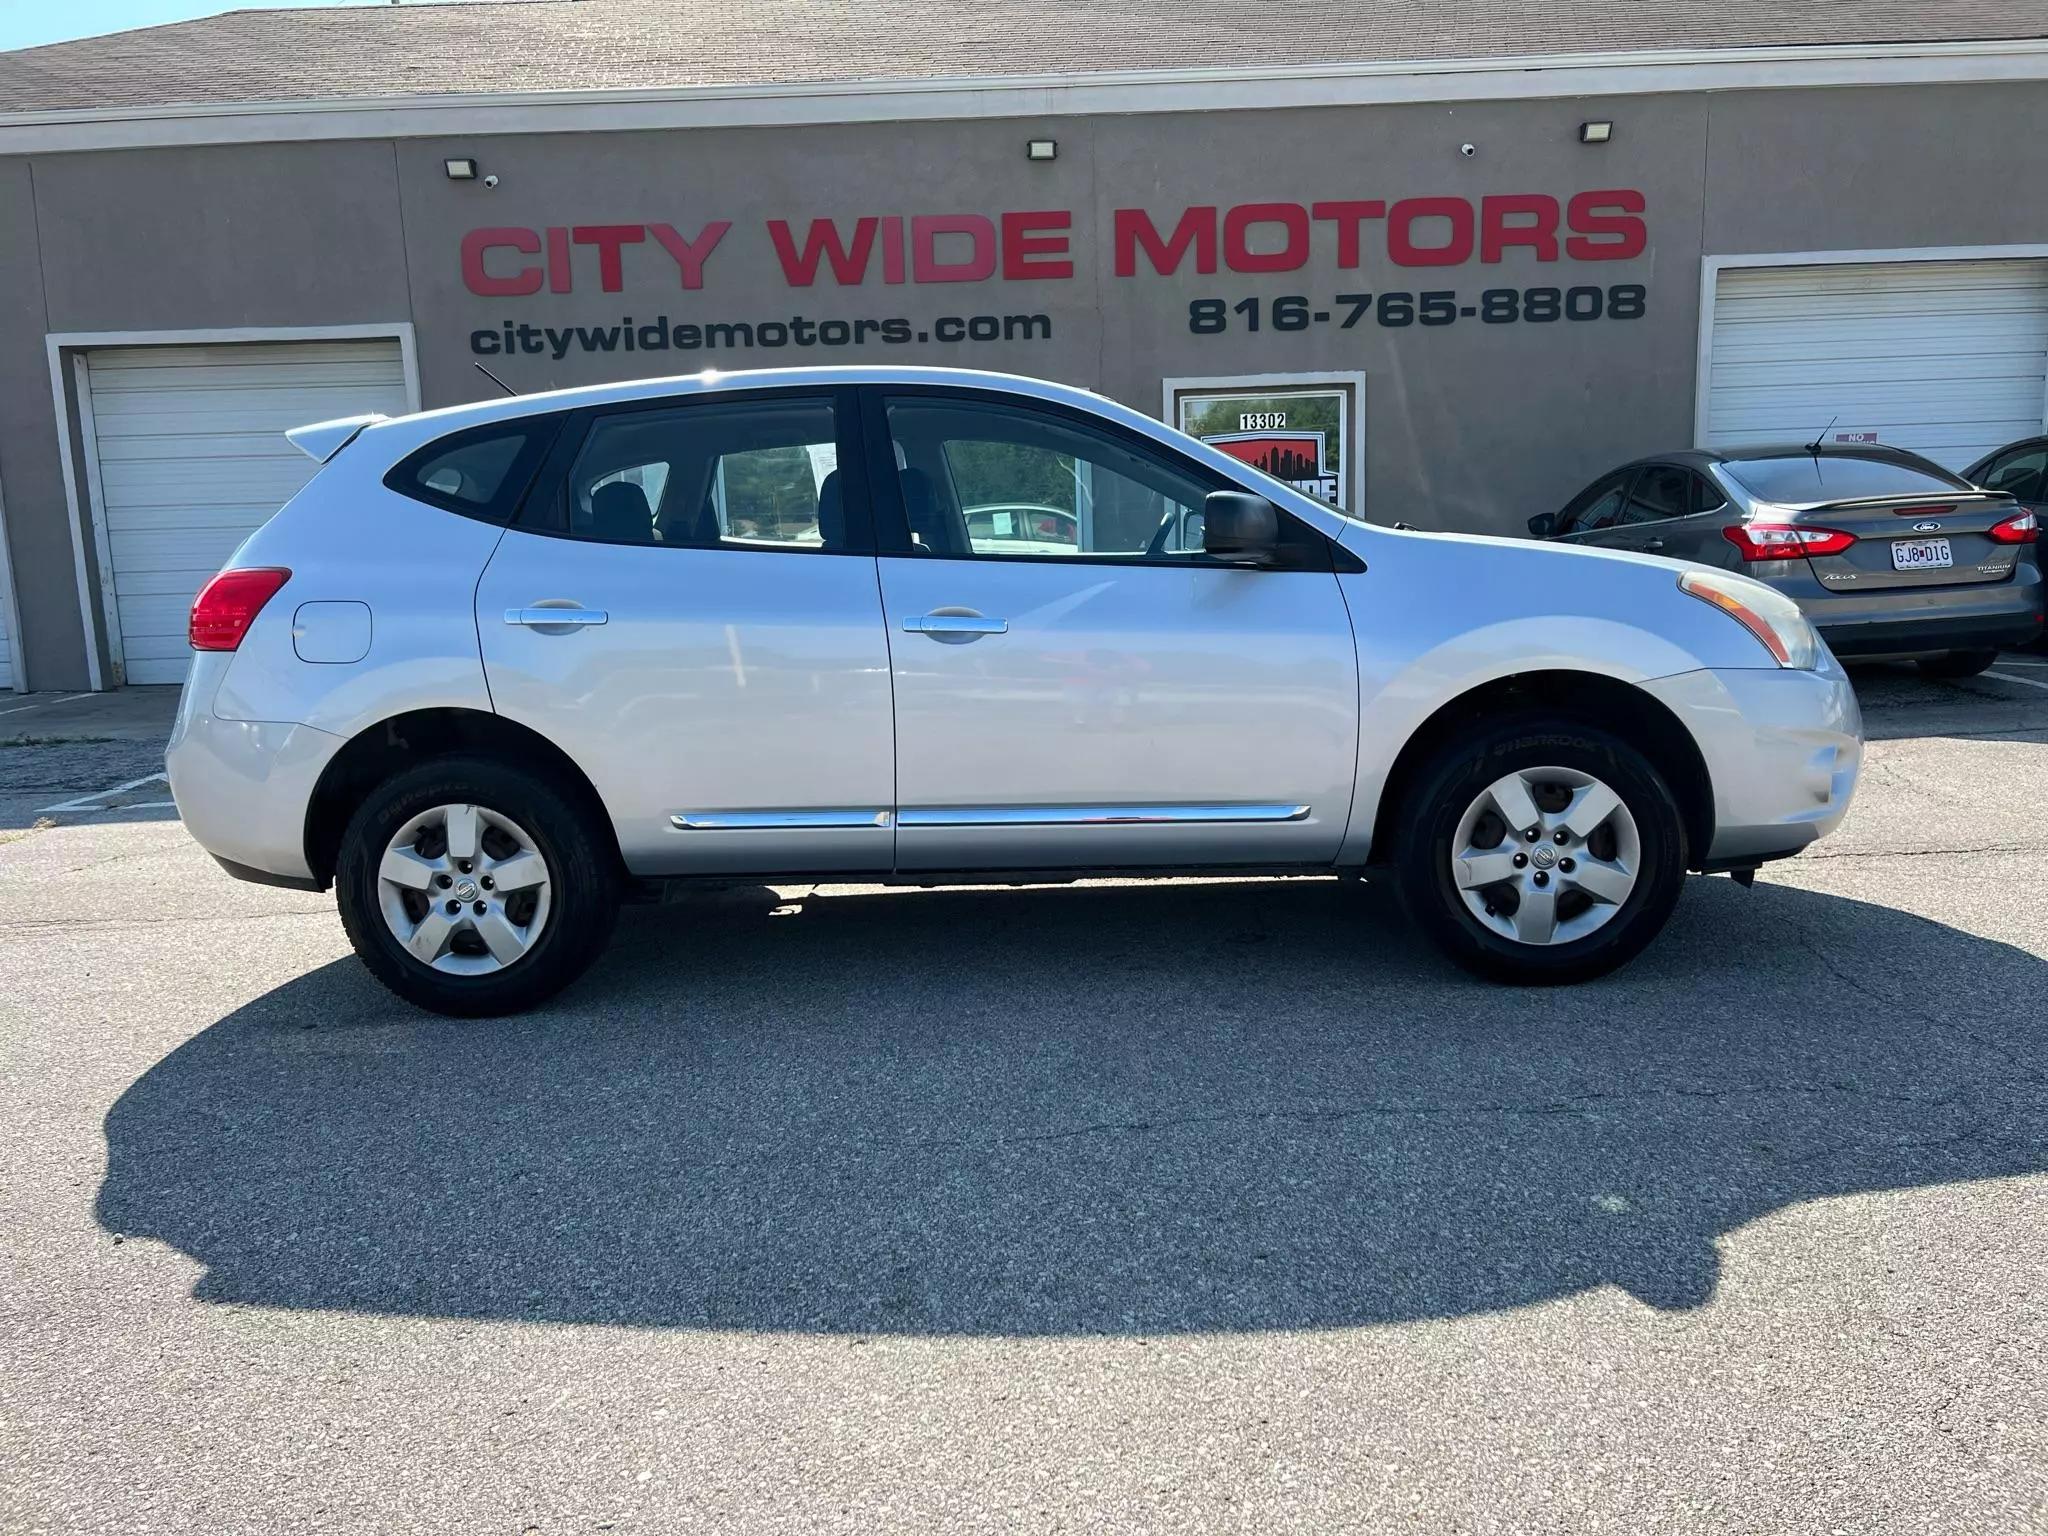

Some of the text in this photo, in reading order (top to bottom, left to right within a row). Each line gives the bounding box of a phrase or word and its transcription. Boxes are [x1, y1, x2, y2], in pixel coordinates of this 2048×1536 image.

[460, 190, 1647, 297] CITY WIDE MOTORS
[470, 307, 1052, 360] citywidemotors.com
[1188, 284, 1647, 334] 816-765-8808
[1241, 413, 1286, 430] 13302
[1848, 433, 1864, 442] NO
